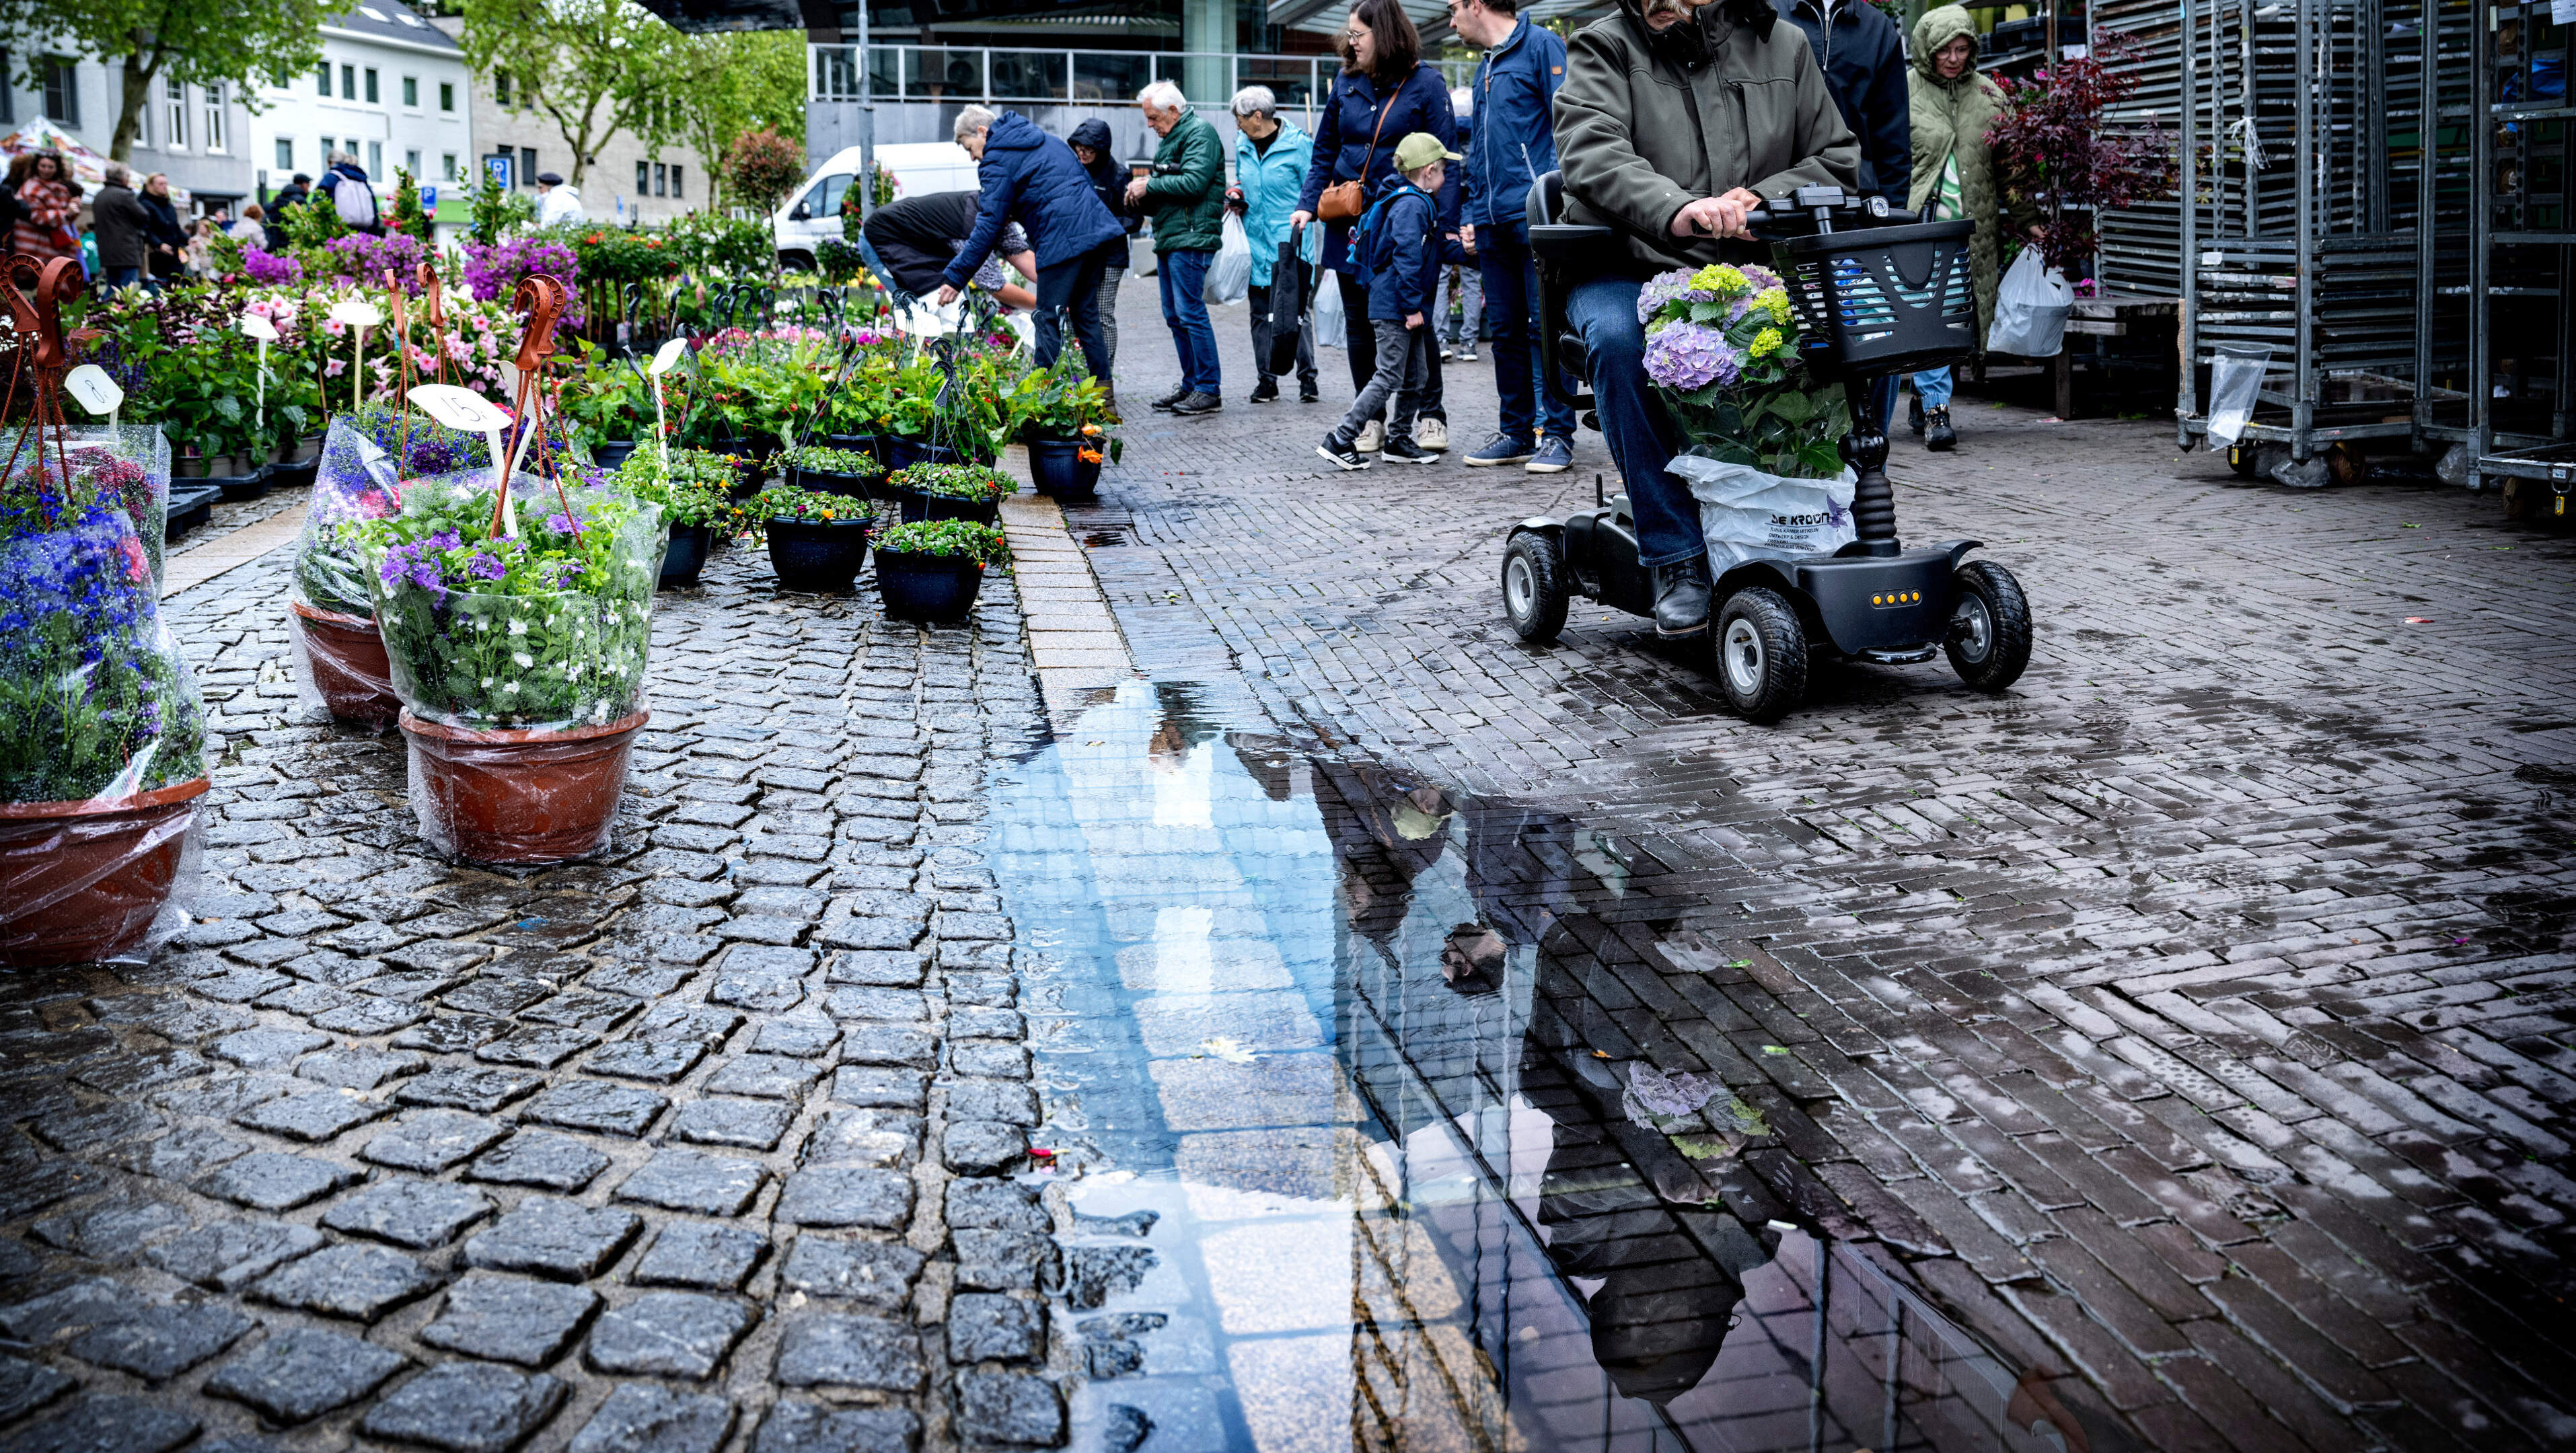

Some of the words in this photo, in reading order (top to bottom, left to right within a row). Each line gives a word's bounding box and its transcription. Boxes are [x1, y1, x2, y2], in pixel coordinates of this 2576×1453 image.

[424, 189, 434, 200] P
[1771, 514, 1787, 525] DE
[1790, 513, 1830, 525] KROON
